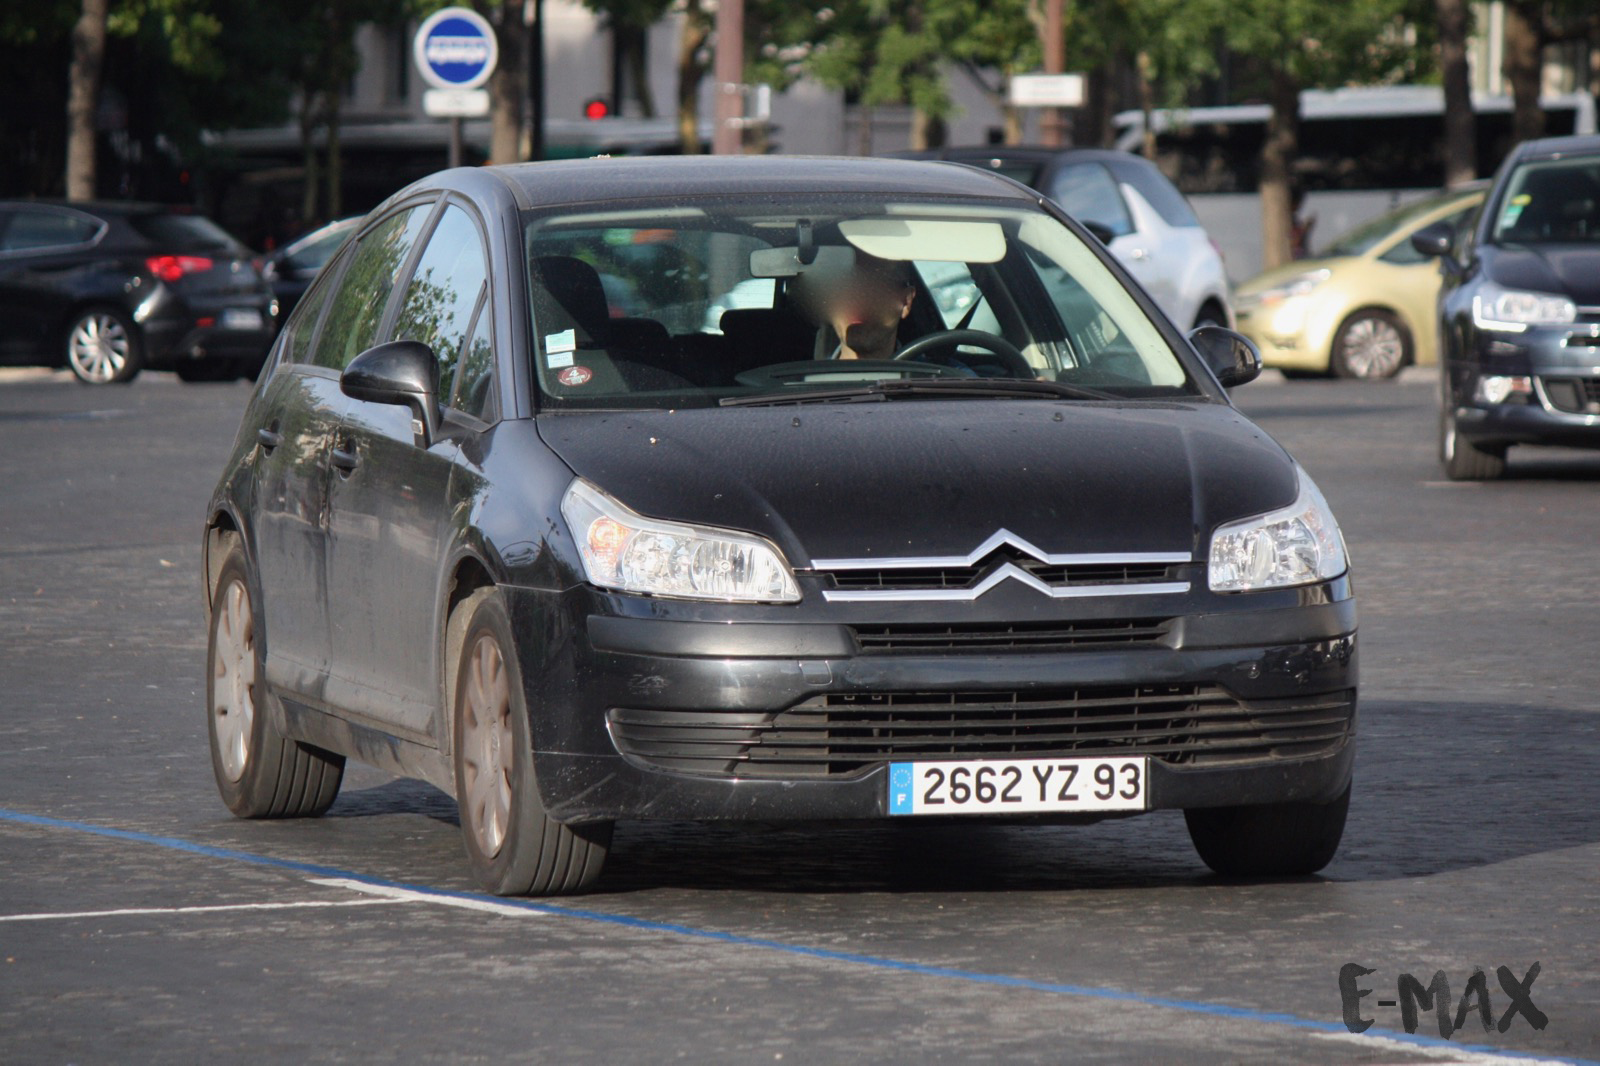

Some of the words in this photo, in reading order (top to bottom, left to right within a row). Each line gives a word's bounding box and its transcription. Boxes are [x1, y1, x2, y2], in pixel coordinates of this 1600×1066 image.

[924, 766, 1022, 804] 2662
[1033, 765, 1079, 802] YZ
[1093, 763, 1140, 800] 93
[897, 794, 906, 806] F
